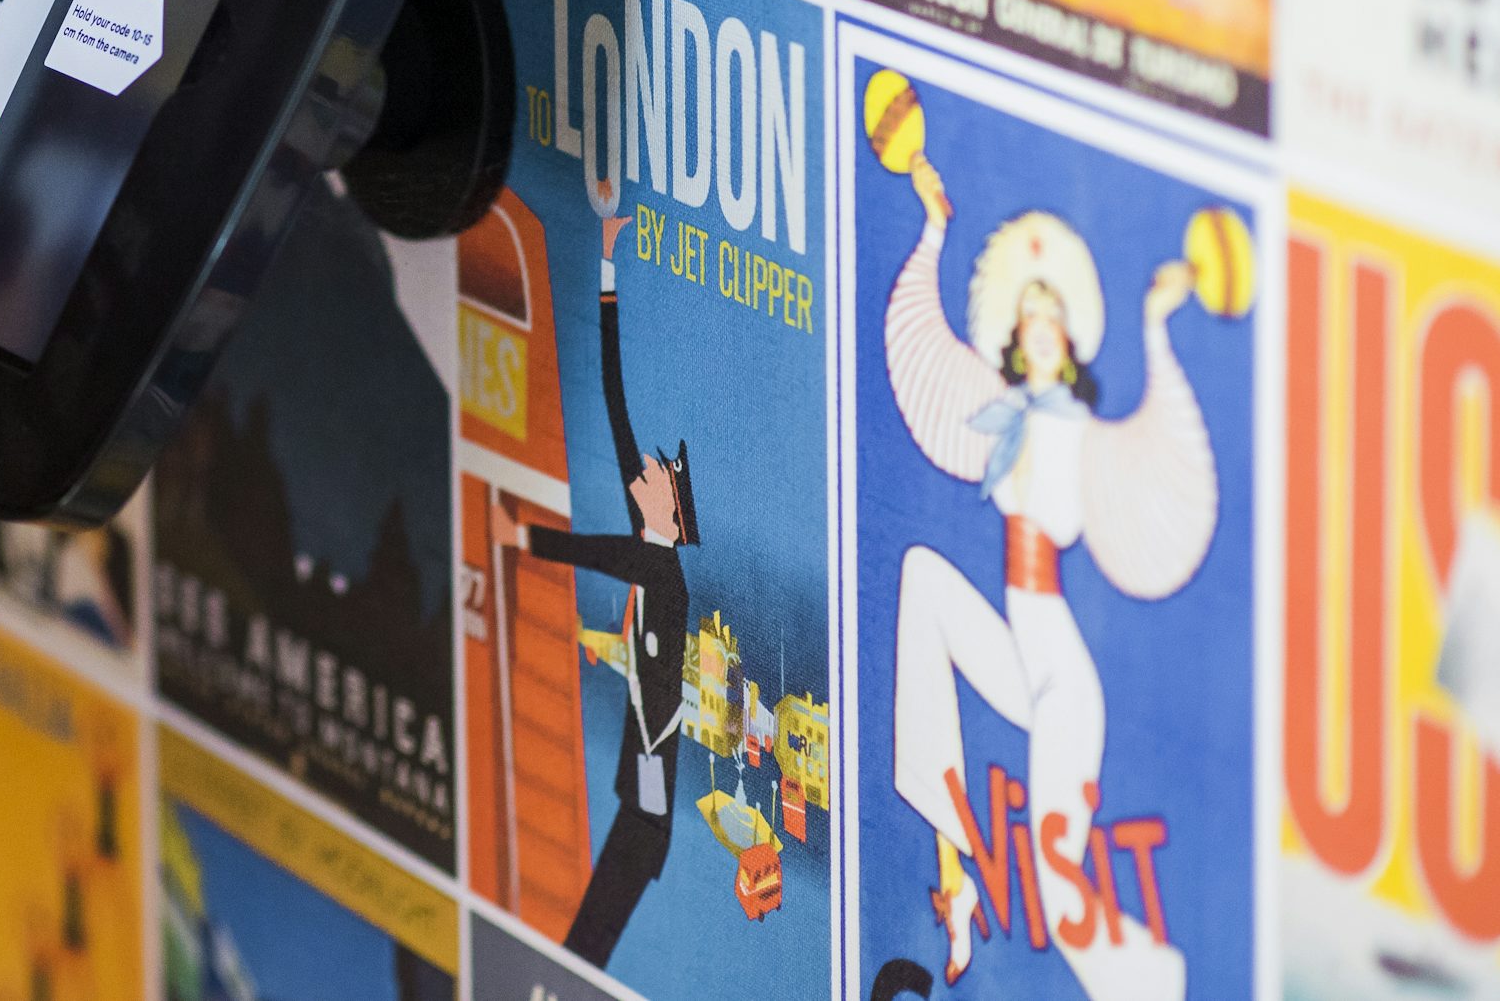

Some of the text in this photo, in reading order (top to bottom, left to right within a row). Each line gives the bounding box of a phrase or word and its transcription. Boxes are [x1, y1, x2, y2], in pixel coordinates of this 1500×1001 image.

[63, 26, 140, 65] cm from the camera
[72, 4, 153, 46] Hold your code 10-15
[526, 85, 551, 147] TO
[637, 204, 814, 335] BY JET CLIPPER
[246, 610, 449, 775] AMERICA
